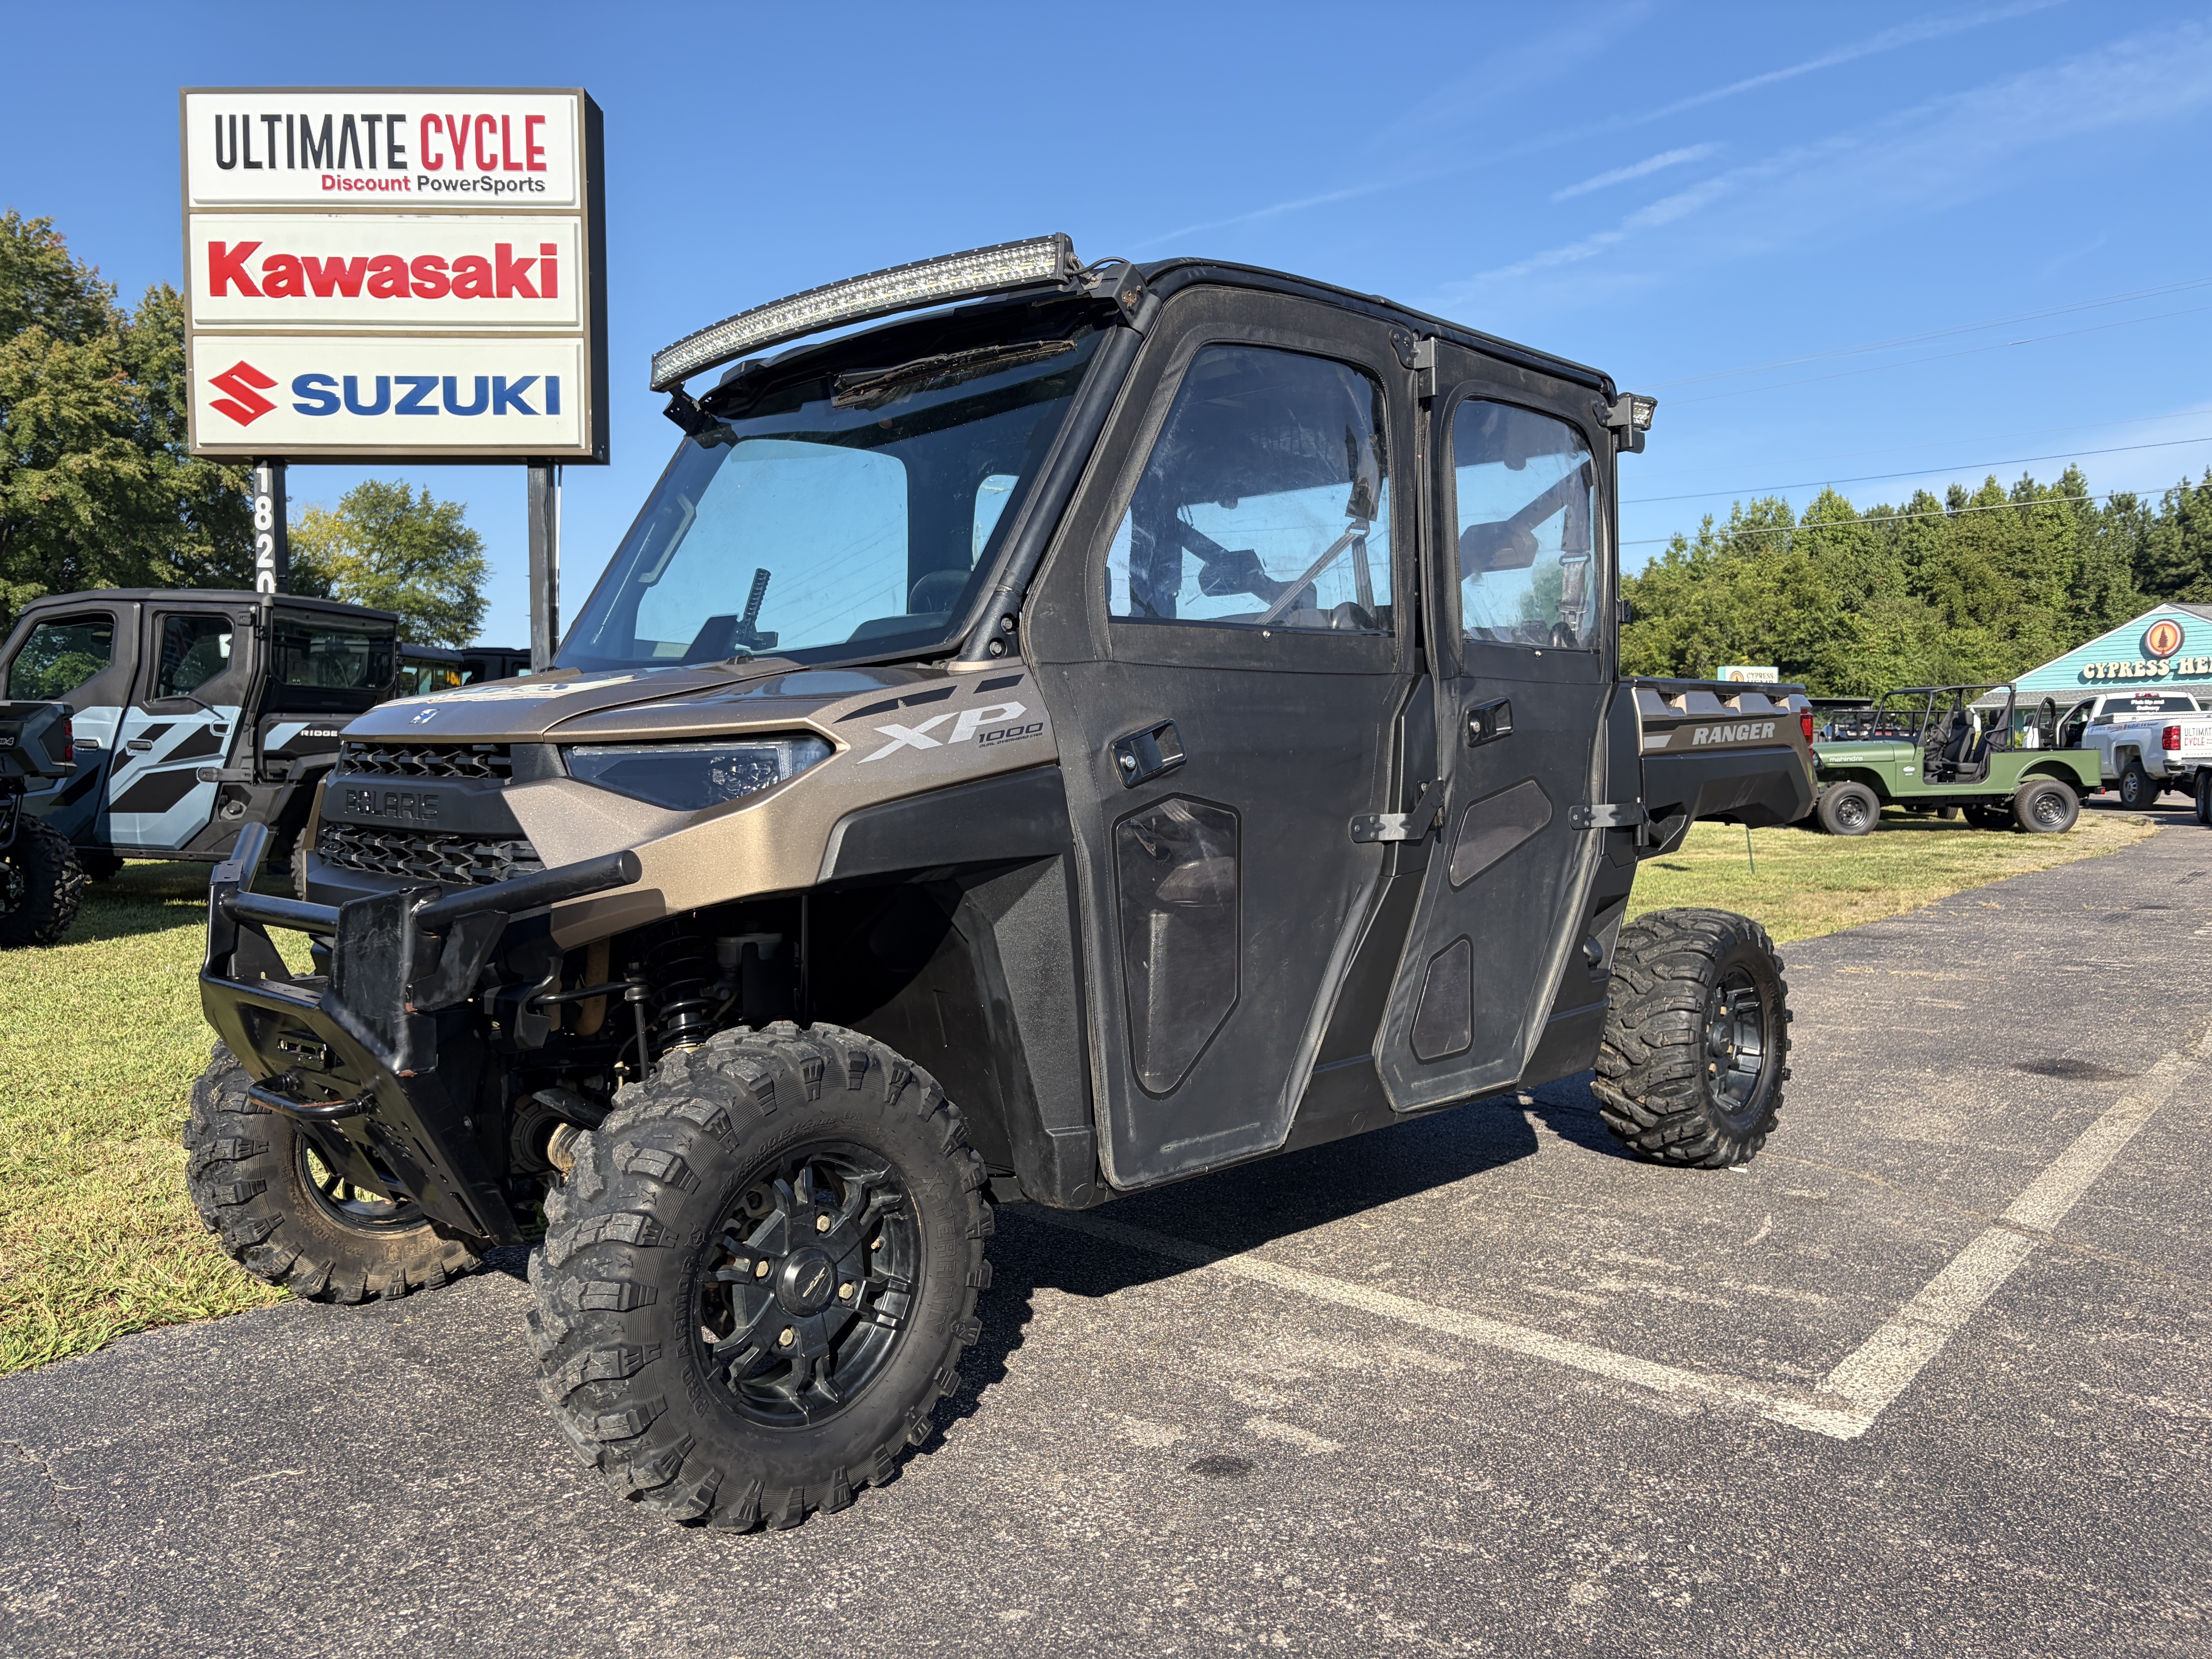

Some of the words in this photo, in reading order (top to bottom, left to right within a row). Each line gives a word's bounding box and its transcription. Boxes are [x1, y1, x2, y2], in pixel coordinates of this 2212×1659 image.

[215, 114, 407, 170] ULTIMATE
[421, 114, 547, 172] CYCLE
[322, 175, 411, 191] Discount
[417, 175, 545, 195] PowerSports
[208, 241, 558, 299] Kawasaki
[292, 373, 560, 416] SUZUKI
[2083, 659, 2170, 678] CYPRESS
[2178, 656, 2212, 674] HE
[857, 701, 1027, 764] XP
[979, 722, 1044, 743] 1000
[997, 735, 1029, 744] OVERHEAD
[1692, 722, 1775, 745] RANGER
[2185, 737, 2205, 746] CYCLE
[345, 789, 439, 821] POLARIS
[921, 1167, 958, 1335] X-TERRAIN
[674, 1255, 696, 1358] ARMOR
[681, 1363, 709, 1419] PRO
